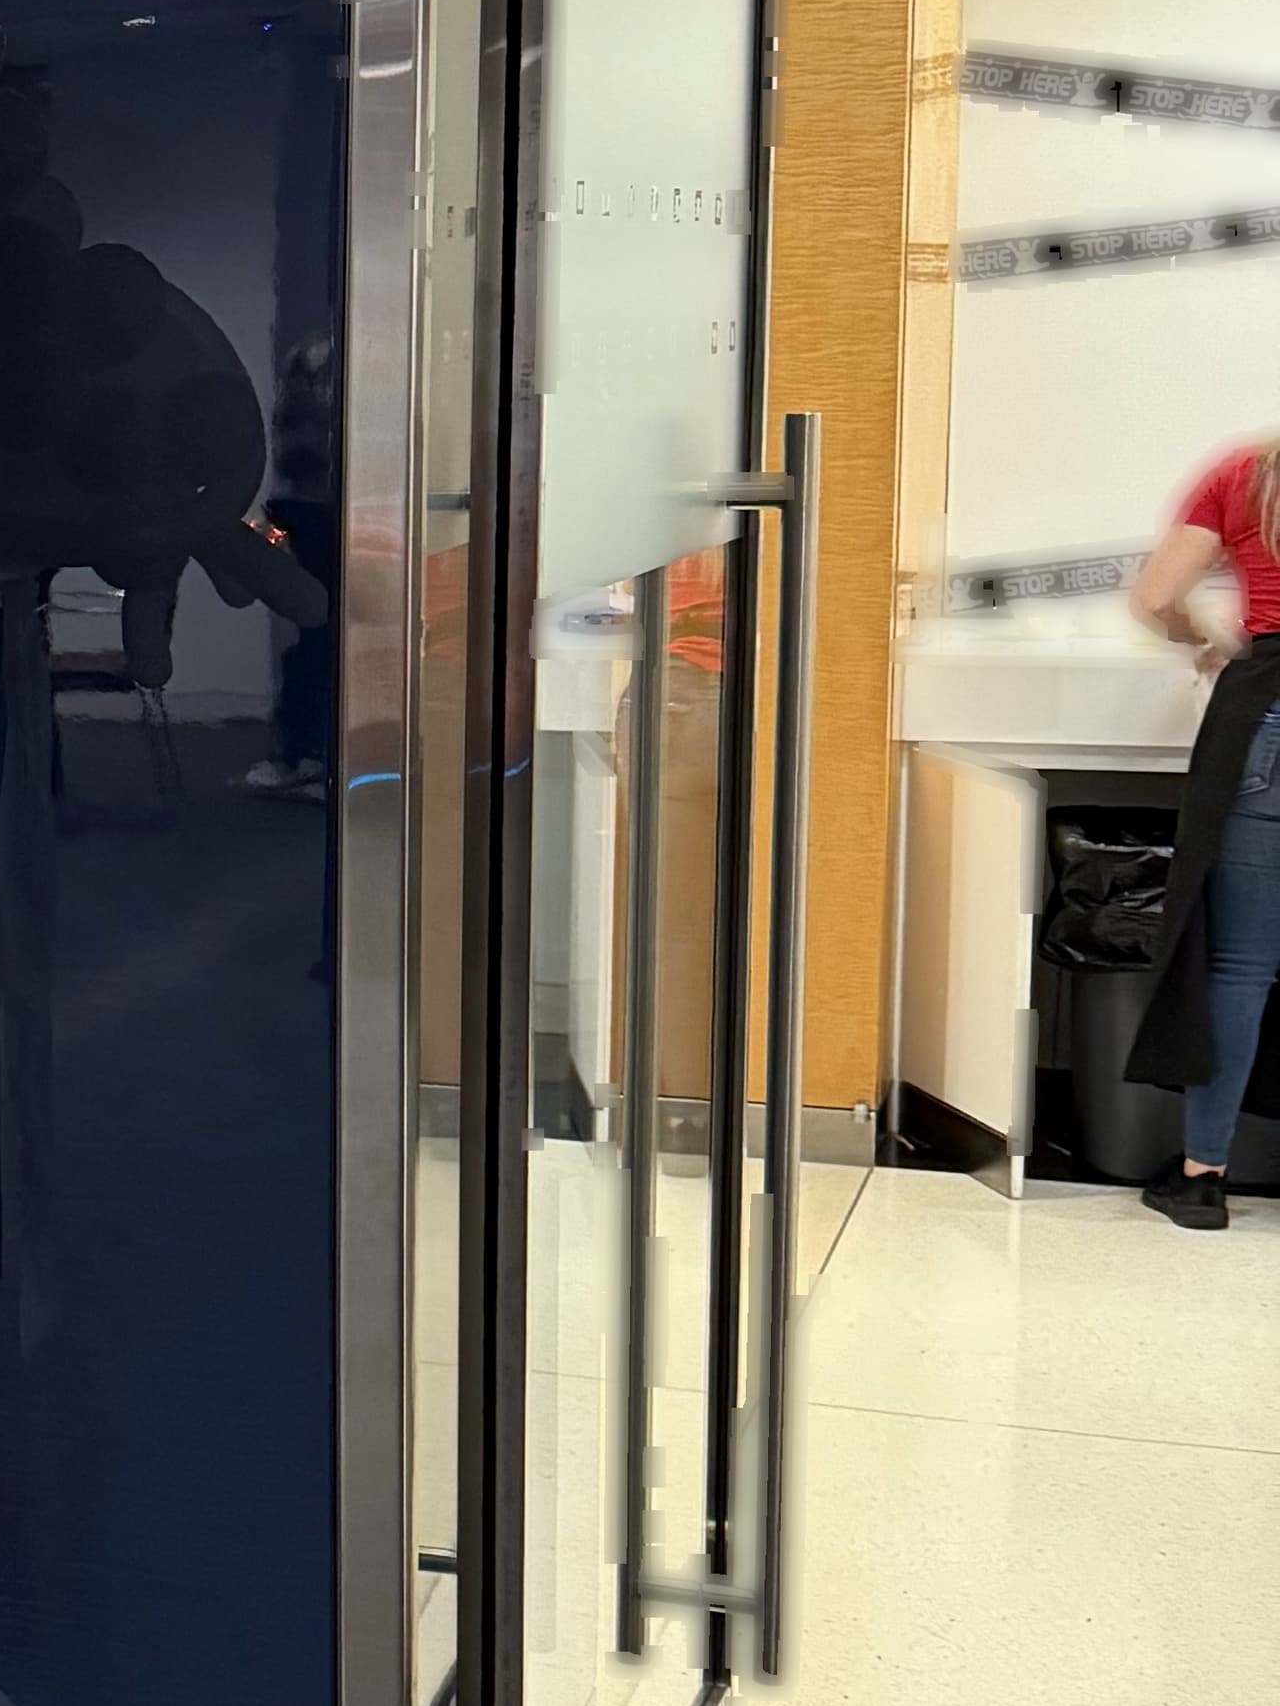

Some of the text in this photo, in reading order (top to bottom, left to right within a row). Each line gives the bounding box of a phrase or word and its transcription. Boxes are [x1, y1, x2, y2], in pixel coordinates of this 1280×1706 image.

[959, 64, 1074, 96] STOP HERE
[1128, 85, 1249, 119] STOP HERE
[1070, 227, 1187, 260] STOP HERE
[959, 248, 1013, 274] HERE
[1002, 564, 1117, 597] STOP HERE
